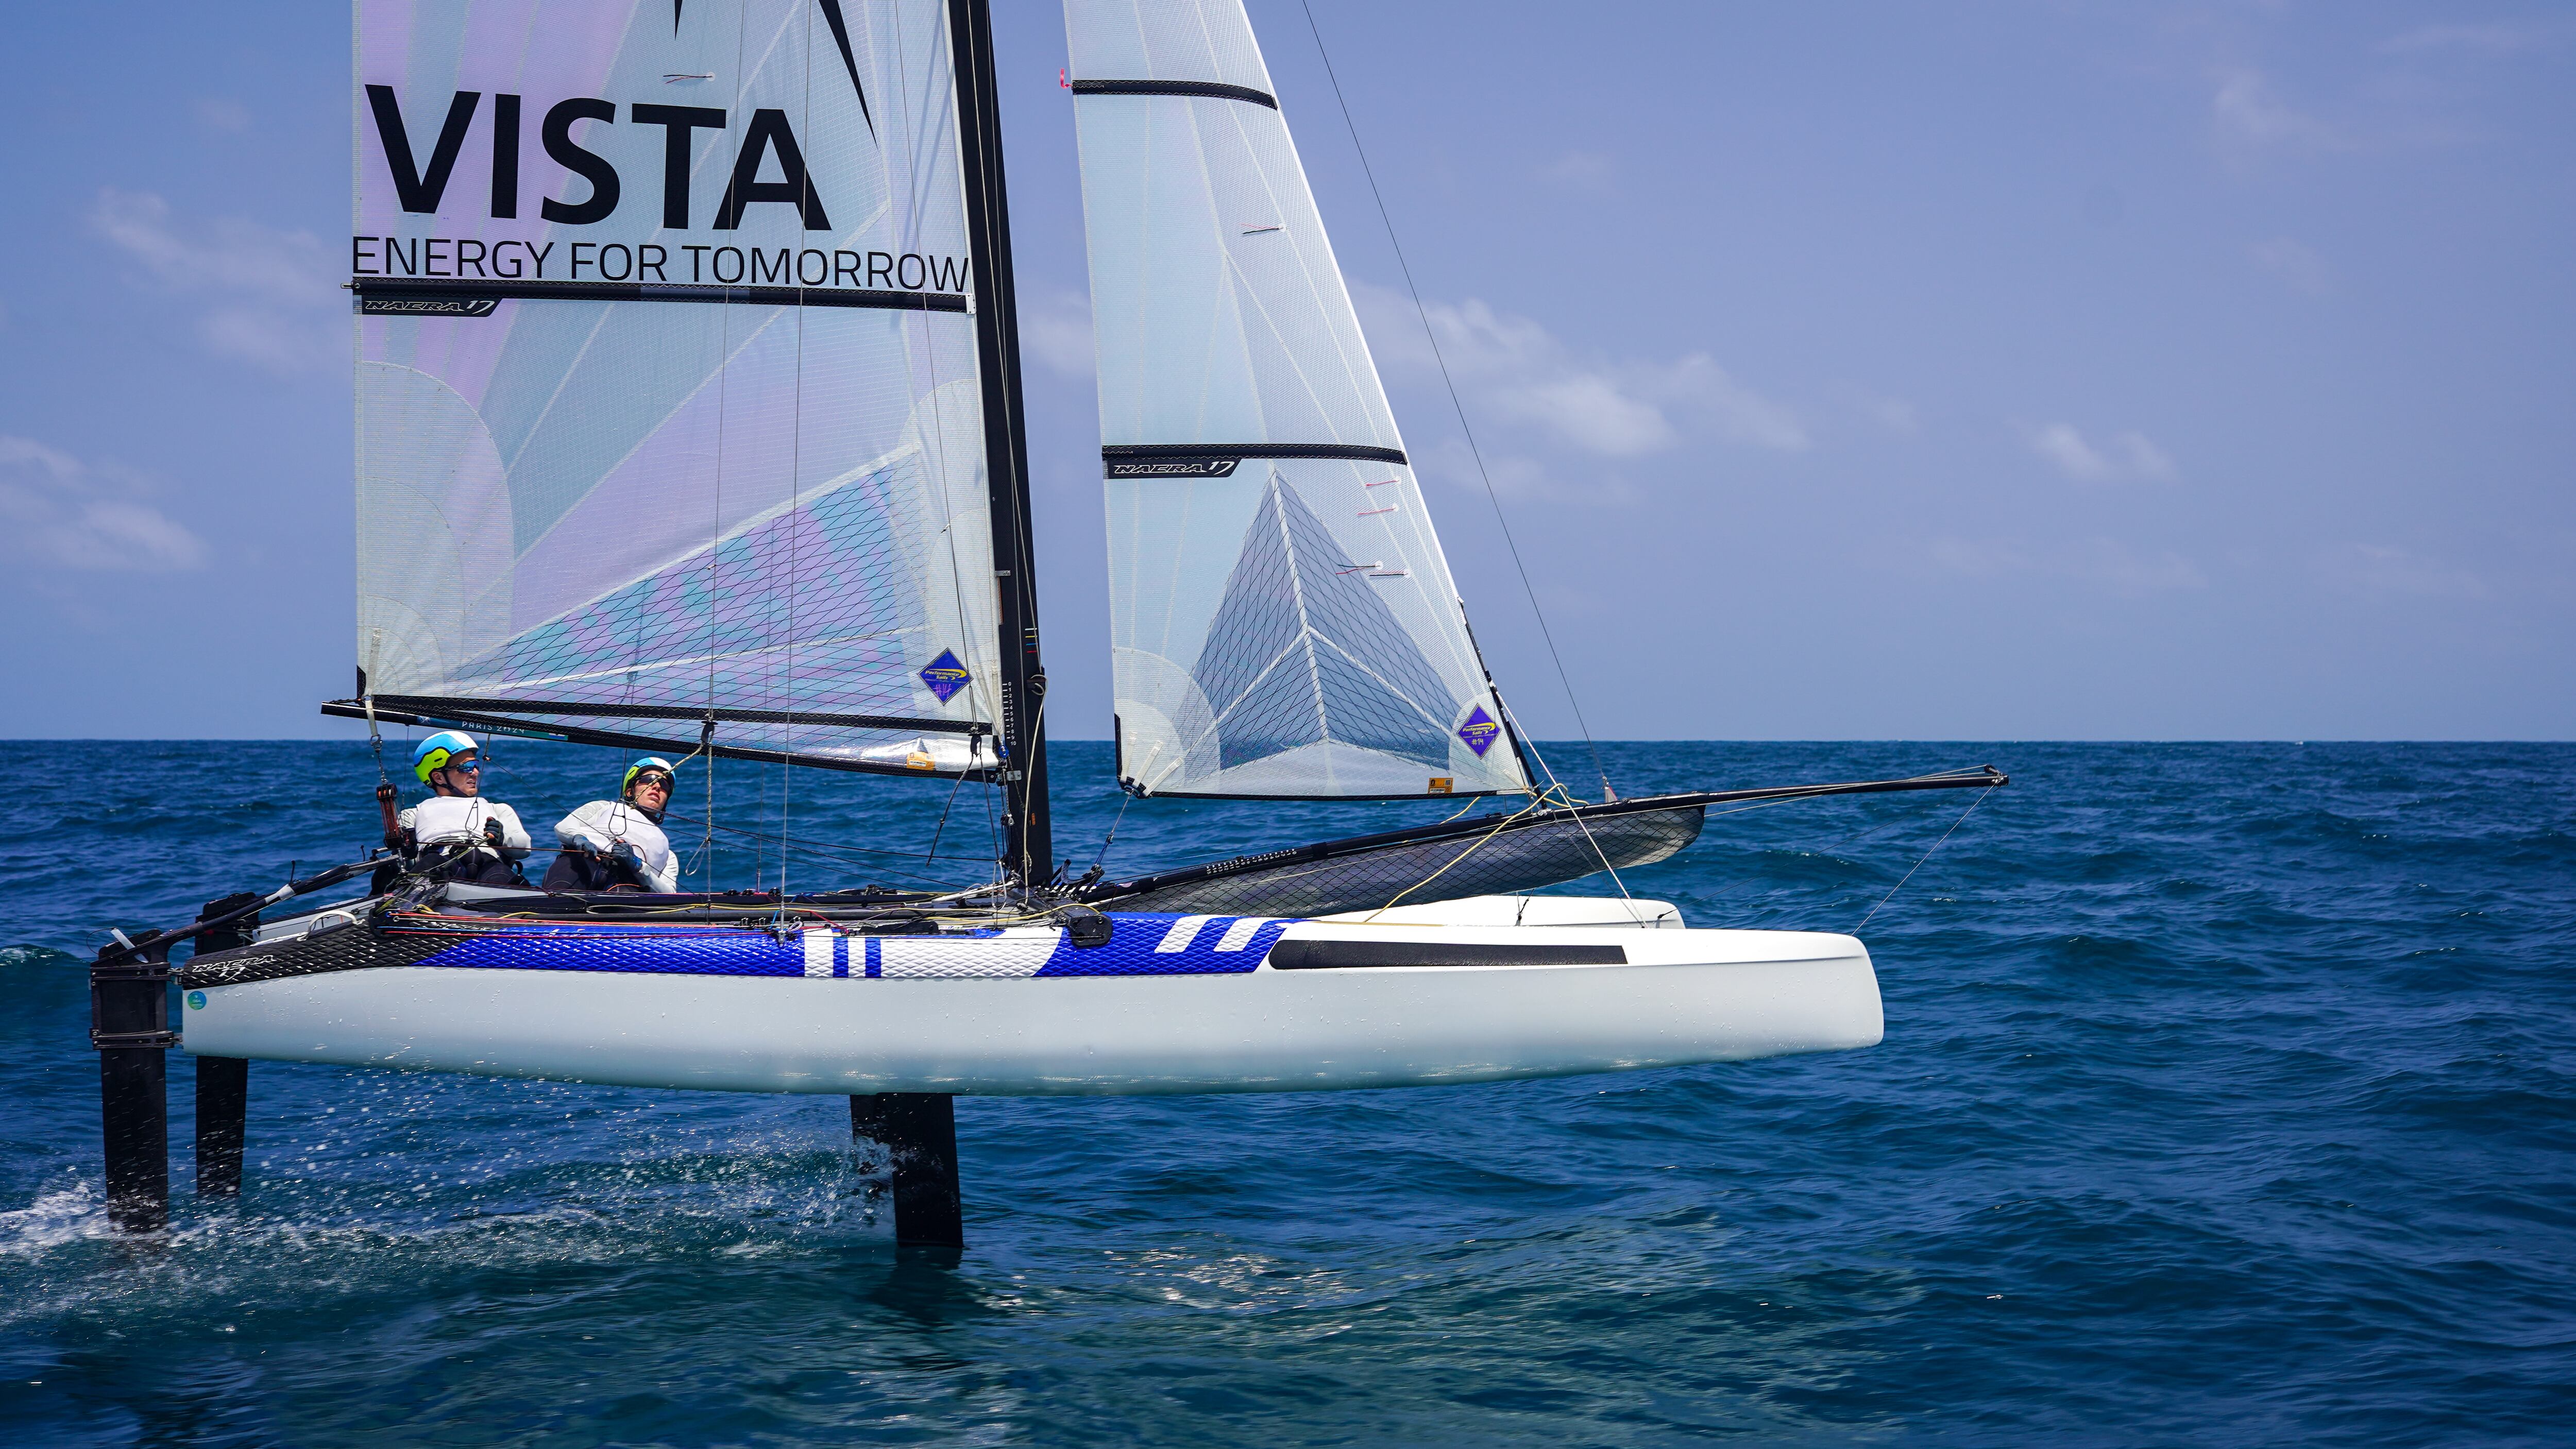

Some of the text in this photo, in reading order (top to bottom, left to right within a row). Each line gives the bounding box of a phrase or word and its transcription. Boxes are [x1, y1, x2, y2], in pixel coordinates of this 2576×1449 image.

[364, 84, 833, 231] VISTA
[353, 236, 969, 291] ENERGY FOR TOMORROW
[466, 300, 495, 314] 17
[1208, 461, 1235, 475] 17
[461, 721, 493, 730] PARIS
[1471, 738, 1484, 746] #14
[218, 967, 246, 981] 17
